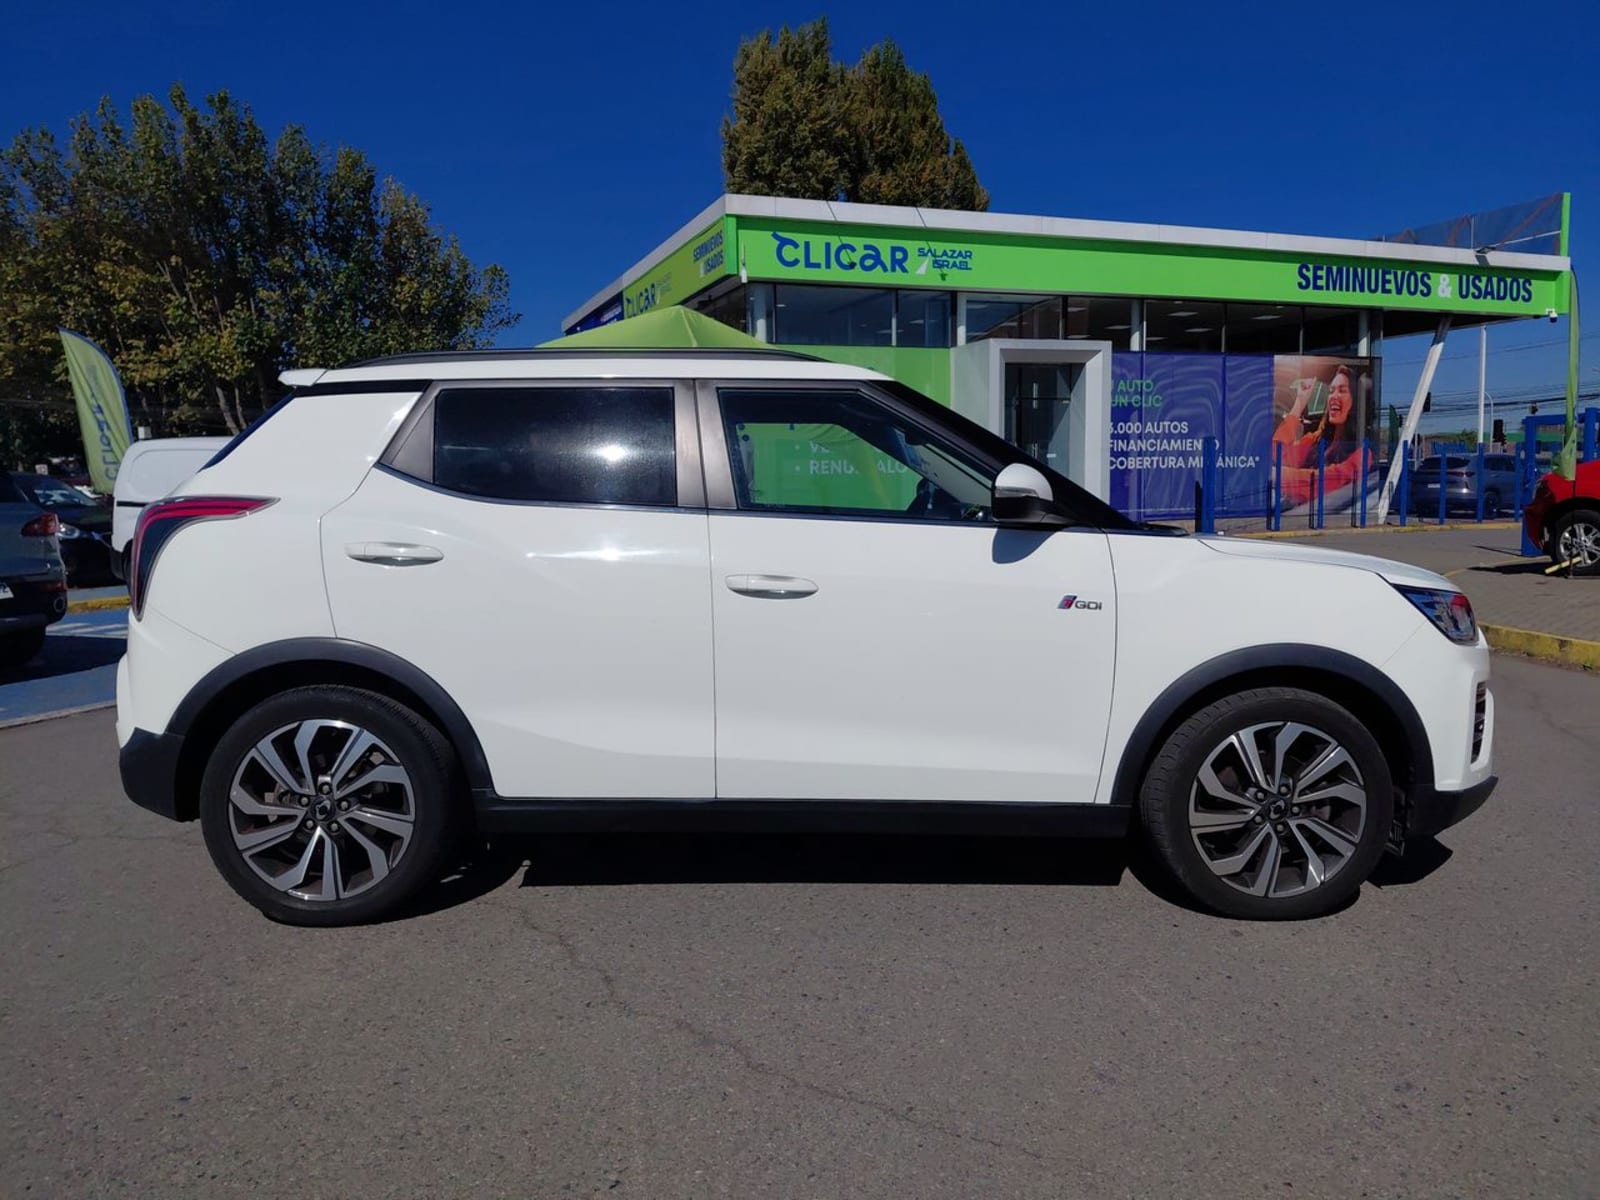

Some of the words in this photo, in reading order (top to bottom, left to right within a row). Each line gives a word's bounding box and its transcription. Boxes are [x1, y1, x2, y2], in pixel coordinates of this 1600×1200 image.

[917, 247, 973, 260] SALAZAR
[932, 258, 973, 271] ISRAEL
[1297, 263, 1432, 297] SEMINUEVOS
[1438, 273, 1452, 298] &
[1458, 274, 1533, 302] USADOS
[1117, 379, 1154, 392] AUTO
[1131, 394, 1163, 407] CLIC
[1145, 421, 1189, 433] AUTOS
[1109, 438, 1219, 451] FINANCIAMIEN
[1109, 456, 1185, 469] COBERTURA
